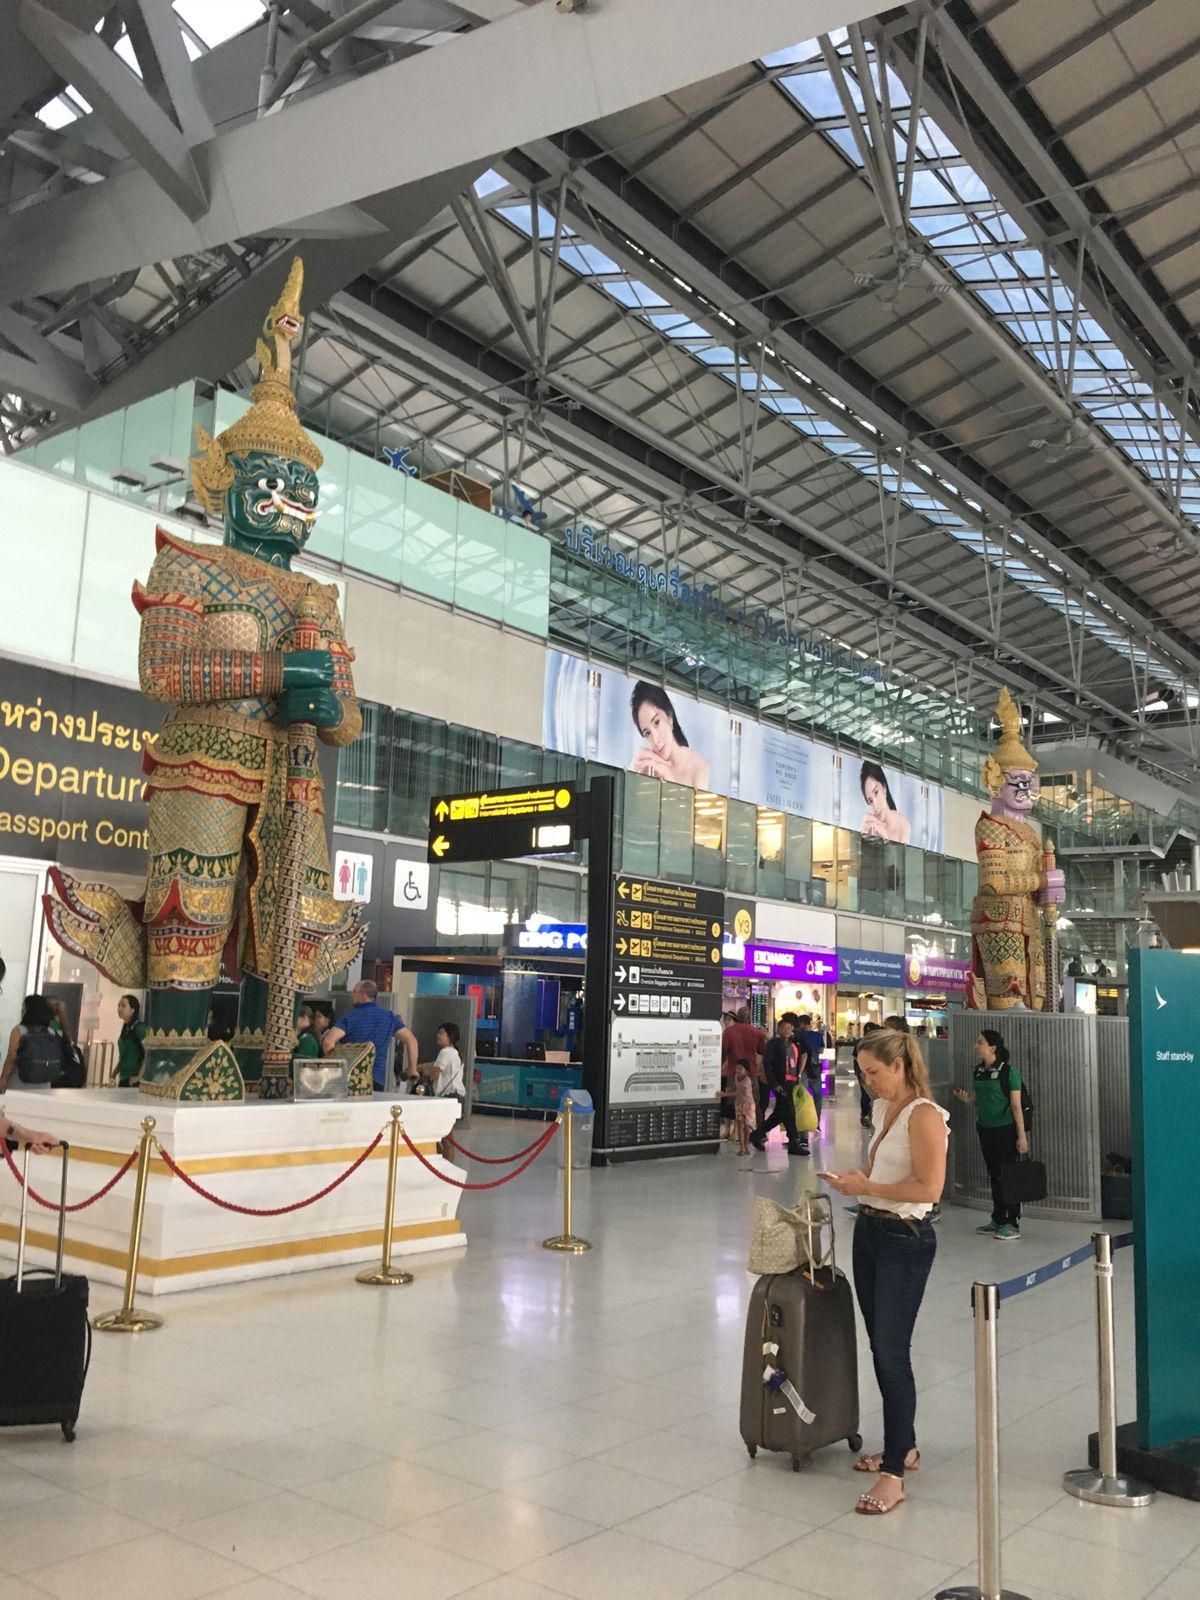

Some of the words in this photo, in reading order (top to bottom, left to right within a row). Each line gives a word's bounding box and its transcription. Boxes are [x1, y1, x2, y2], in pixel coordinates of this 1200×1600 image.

[0, 746, 148, 802] epartur
[95, 820, 149, 850] Cont
[738, 918, 750, 935] Y3
[519, 931, 564, 949] KING
[1156, 1050, 1170, 1061] Staff
[1170, 1050, 1194, 1063] stand-by
